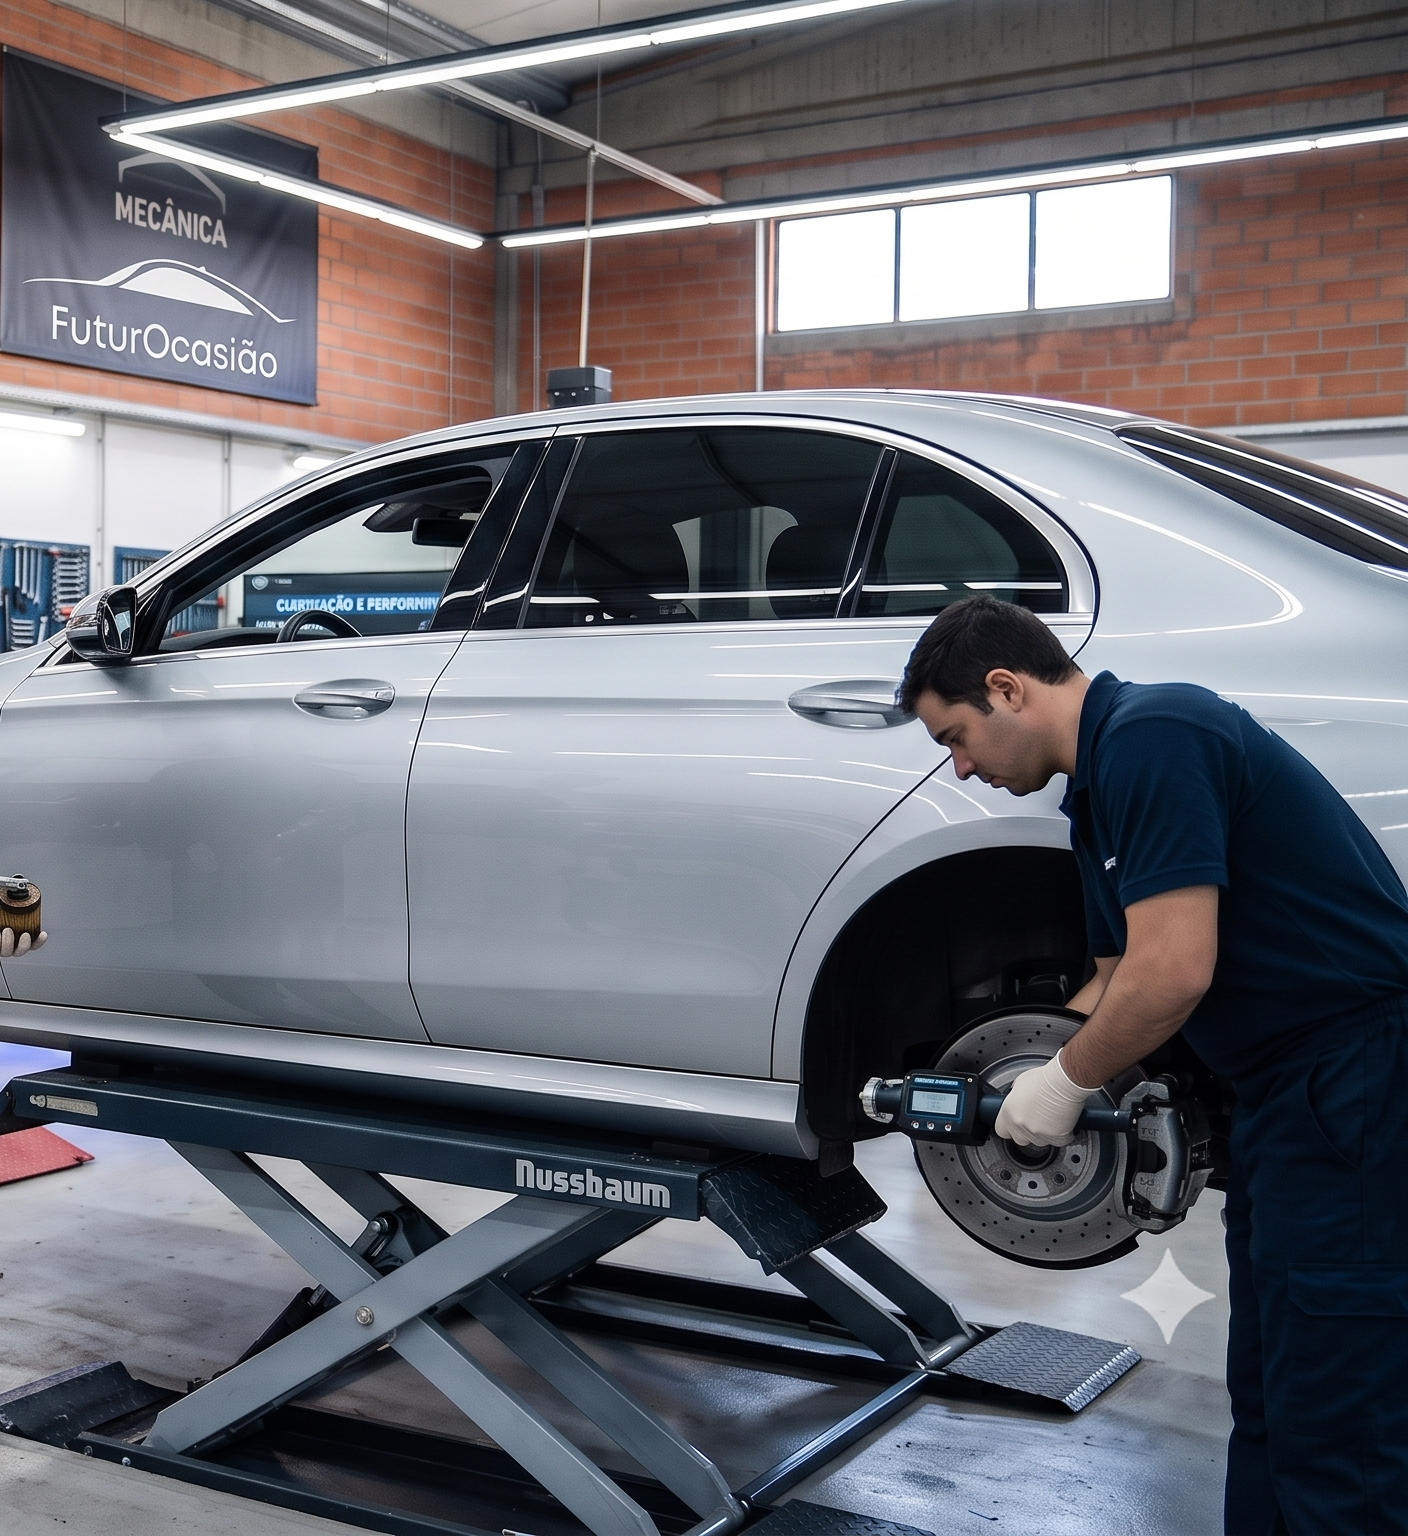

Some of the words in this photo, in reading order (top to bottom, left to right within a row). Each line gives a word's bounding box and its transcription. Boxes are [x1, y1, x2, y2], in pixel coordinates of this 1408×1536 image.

[115, 192, 228, 248] MECÂNICA
[52, 304, 278, 379] FuturOcasião
[356, 597, 365, 611] E
[515, 1158, 671, 1209] Nussbaum
